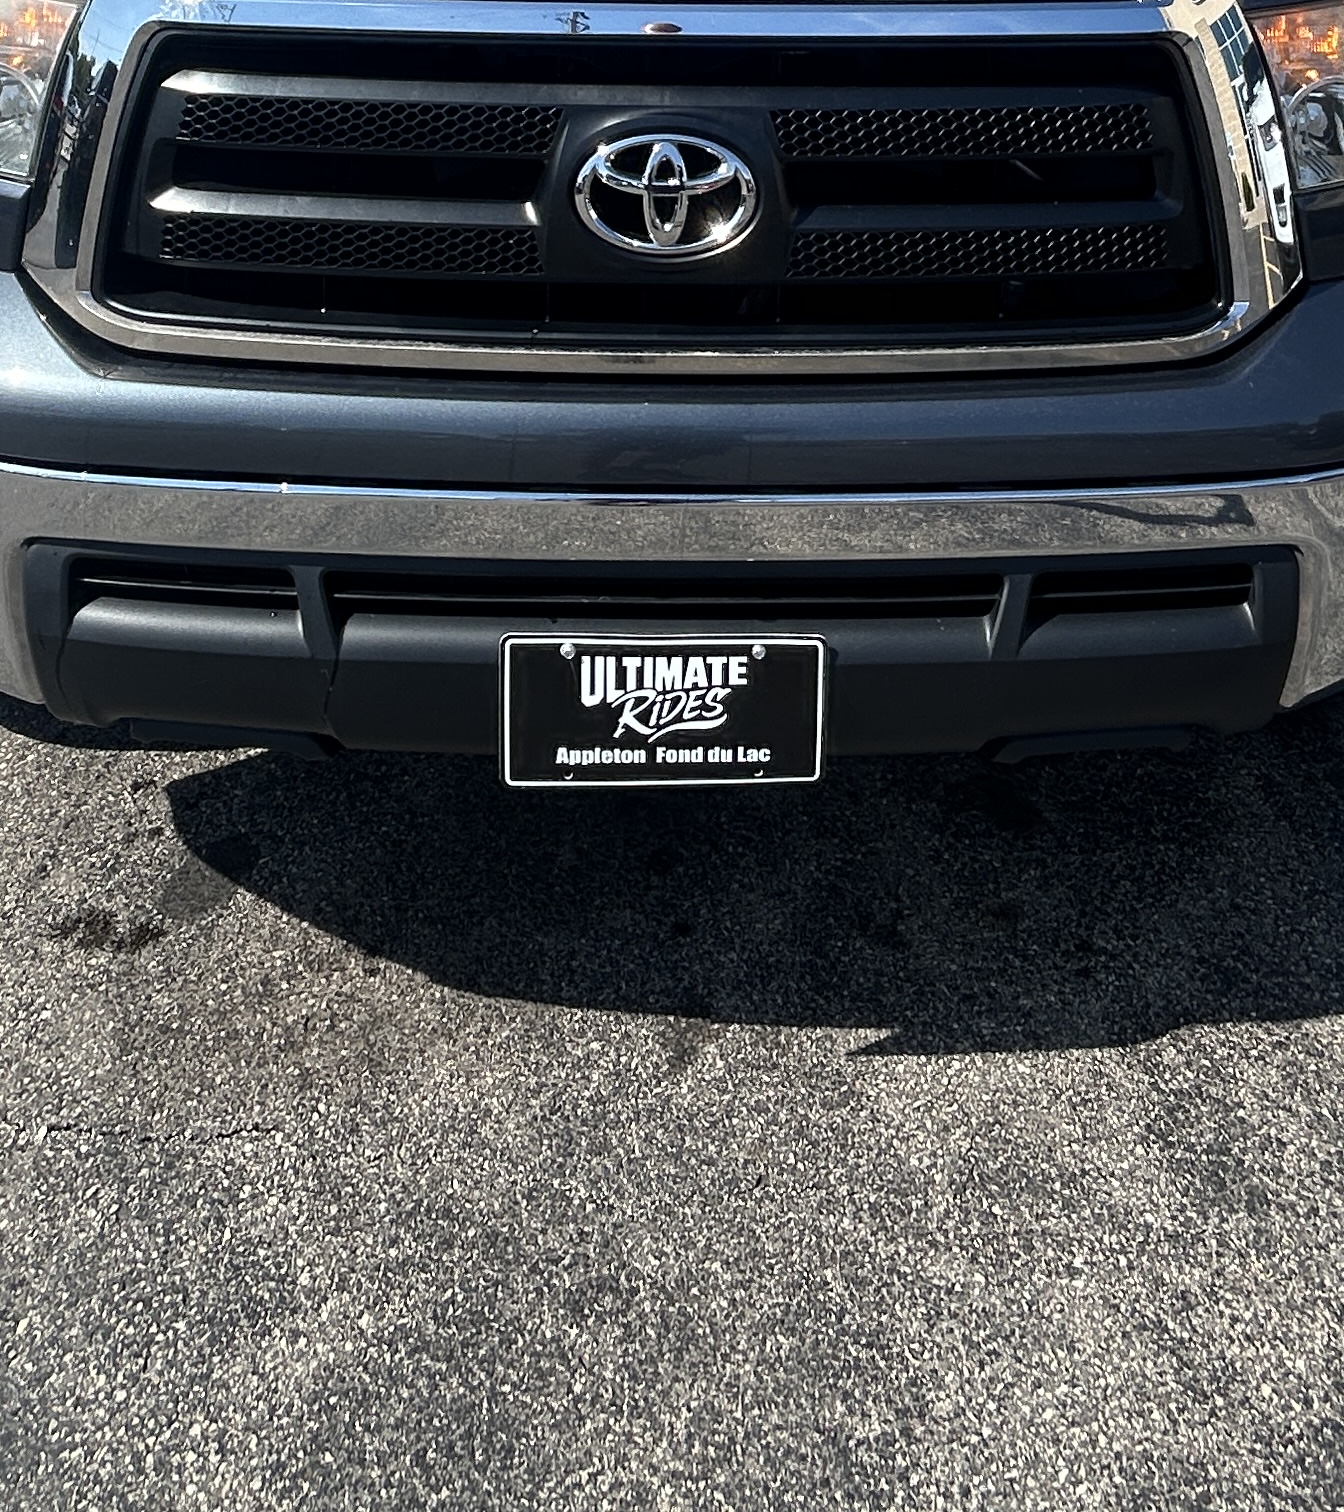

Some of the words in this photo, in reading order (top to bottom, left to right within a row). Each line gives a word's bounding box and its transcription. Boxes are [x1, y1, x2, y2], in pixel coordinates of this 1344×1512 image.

[581, 655, 748, 708] ULTIMATE
[555, 746, 647, 766] Appleton
[656, 746, 704, 764] Fond
[707, 746, 733, 763] du
[737, 746, 771, 763] Lac
